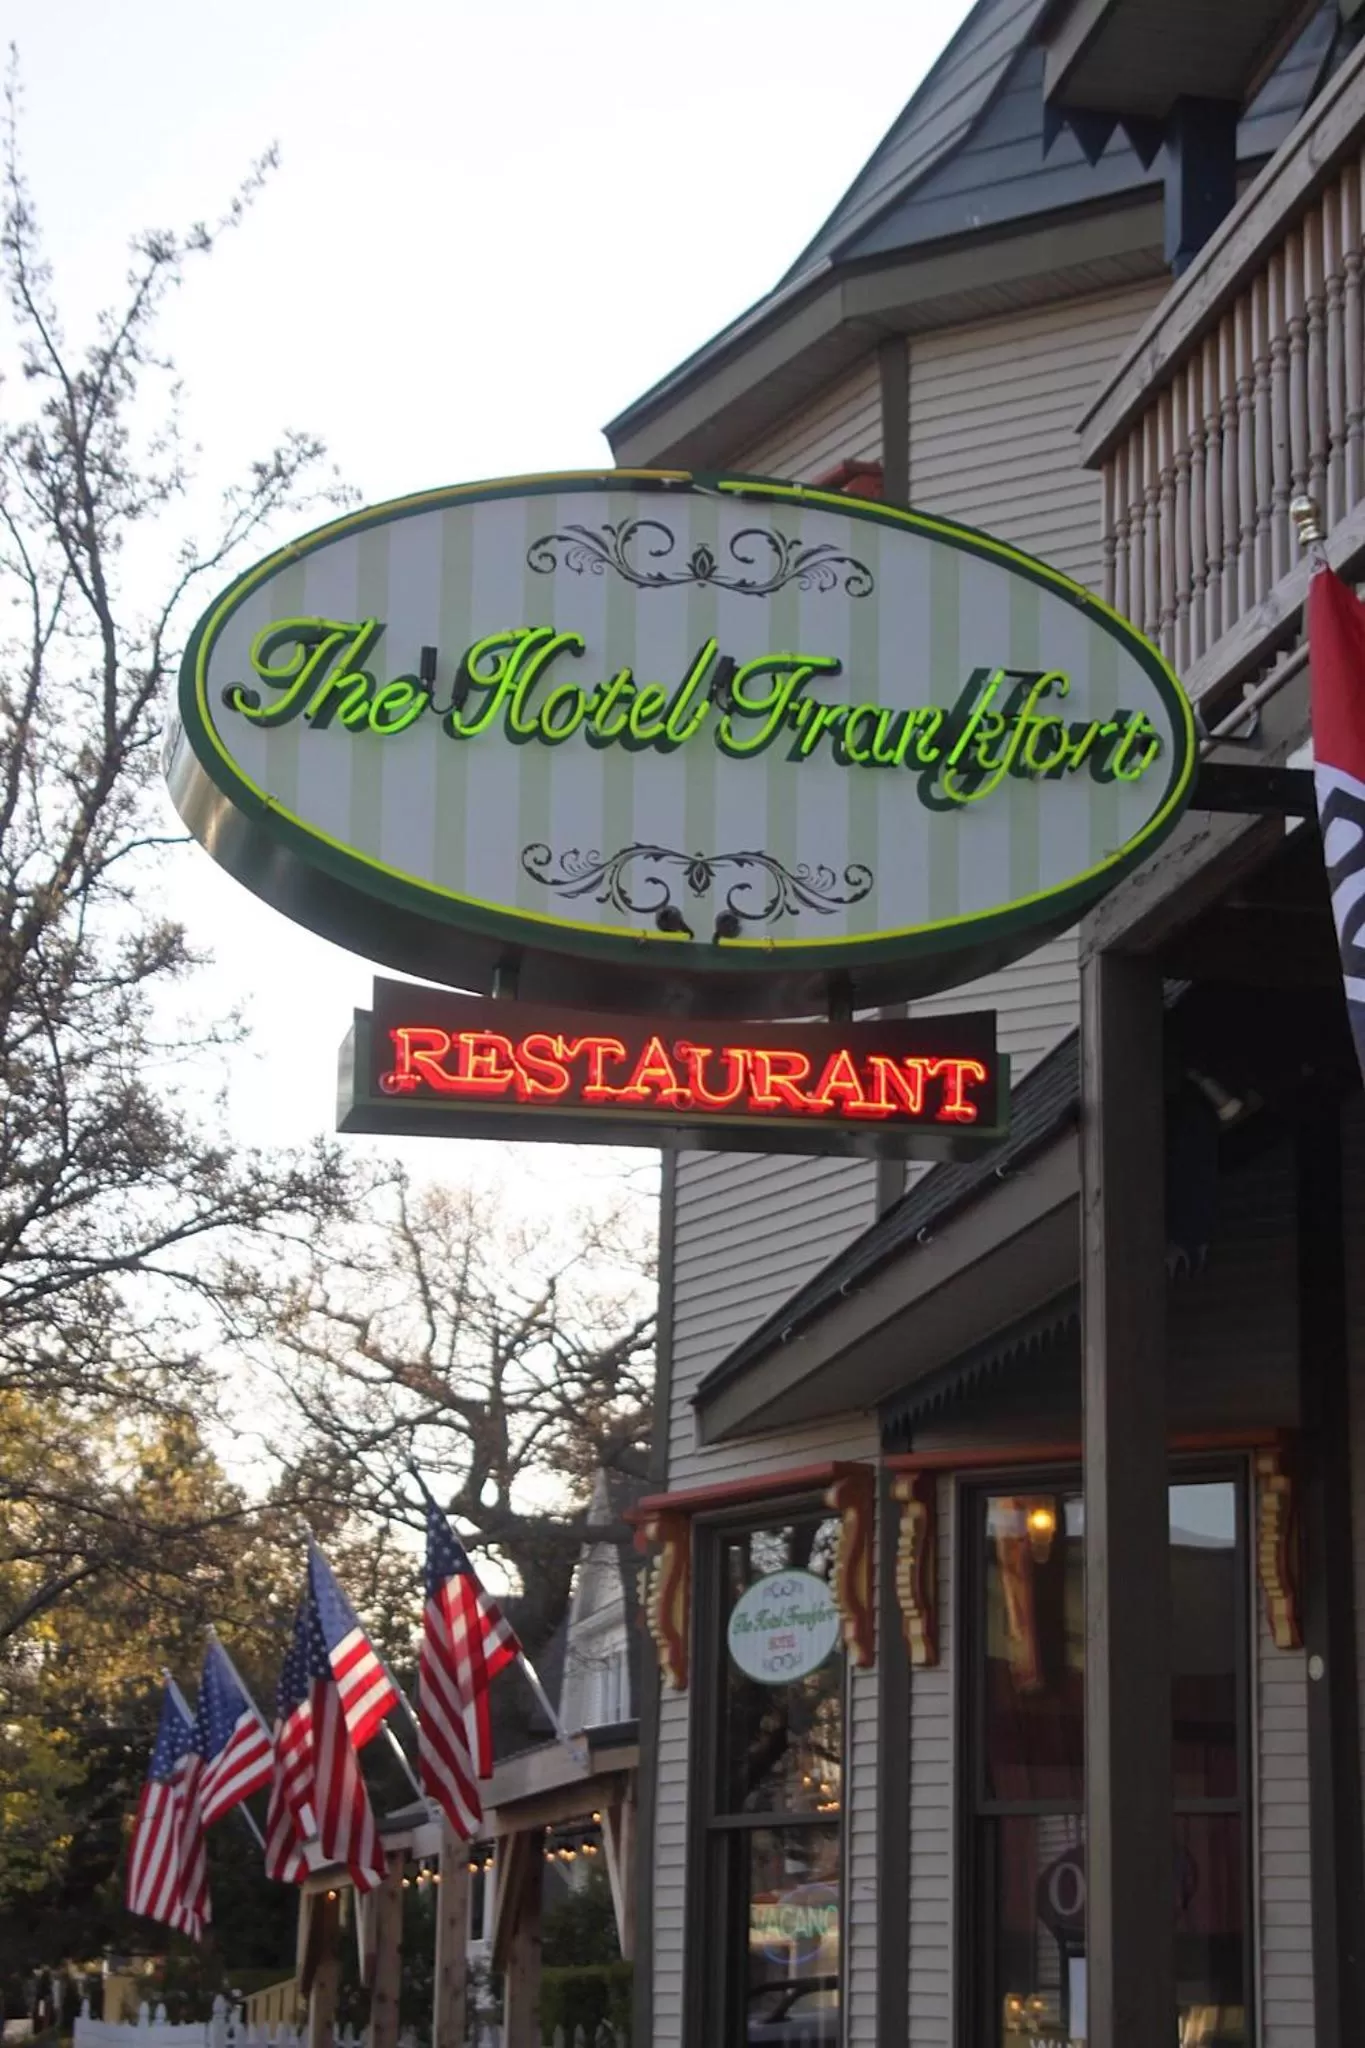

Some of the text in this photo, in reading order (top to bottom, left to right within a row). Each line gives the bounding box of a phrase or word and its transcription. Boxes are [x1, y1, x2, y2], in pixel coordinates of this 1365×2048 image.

[227, 616, 1161, 808] The Hotel Frankfort
[382, 1026, 988, 1120] RESTAURANT
[750, 1905, 838, 1939] VACANC
